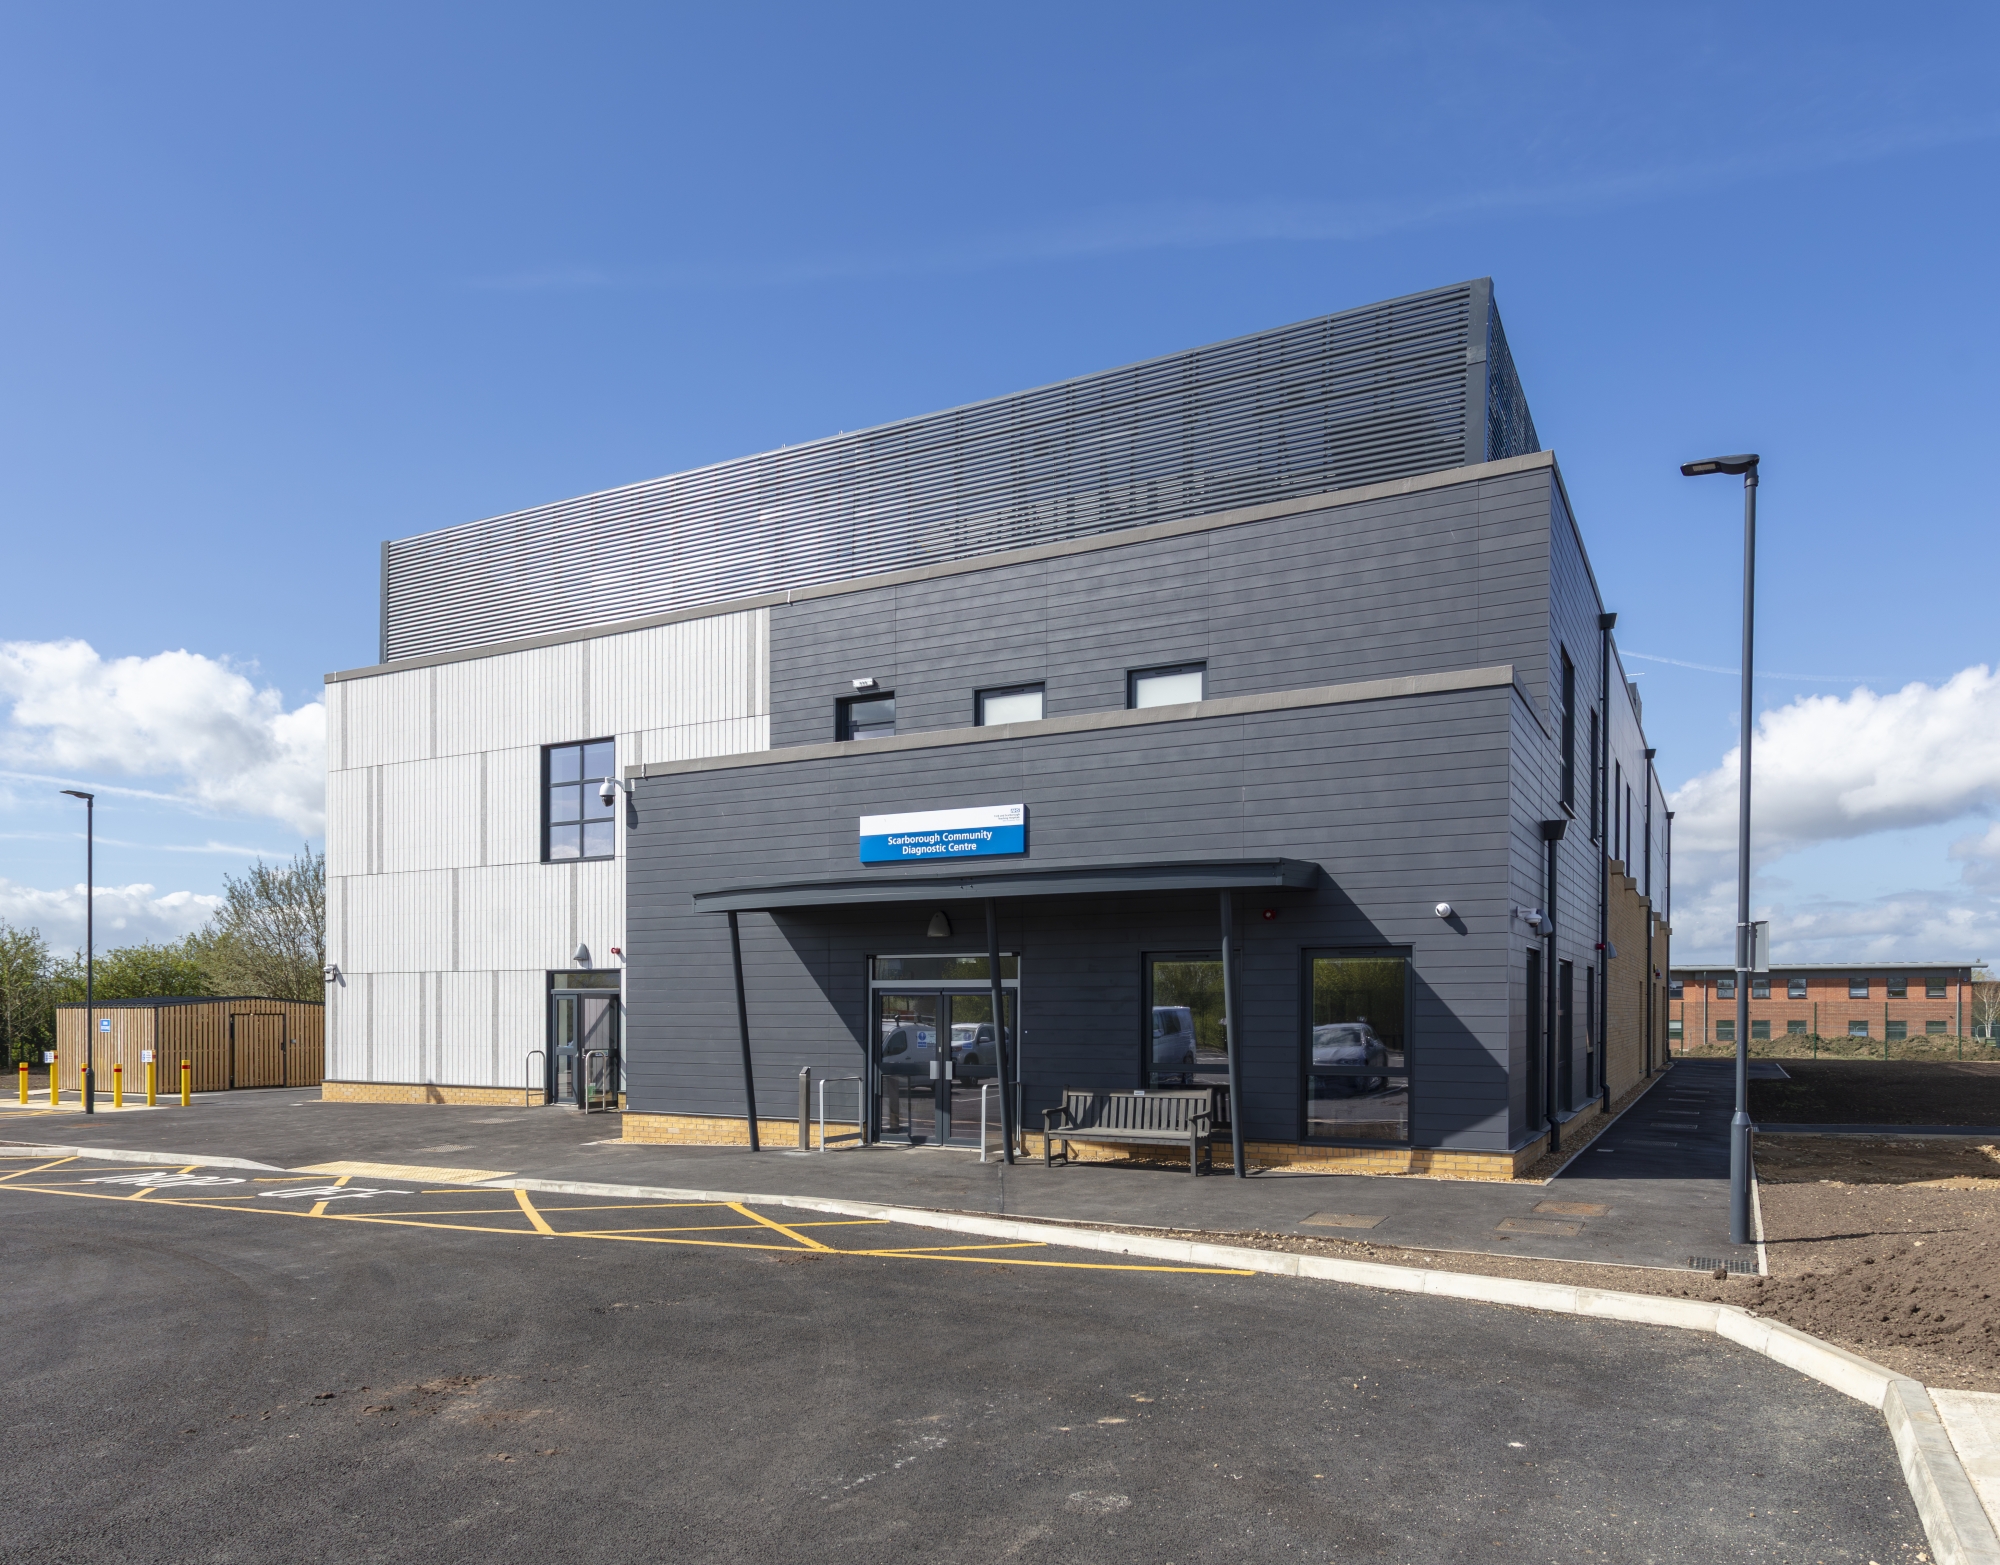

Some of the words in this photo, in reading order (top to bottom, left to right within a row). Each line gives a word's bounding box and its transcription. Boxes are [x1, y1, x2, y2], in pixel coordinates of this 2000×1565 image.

[888, 833, 940, 845] Scarborough
[942, 830, 993, 841] Community
[902, 843, 946, 855] Diagnostic
[948, 842, 977, 851] Centre
[80, 1172, 247, 1188] DROP
[257, 1185, 415, 1201] OFF
